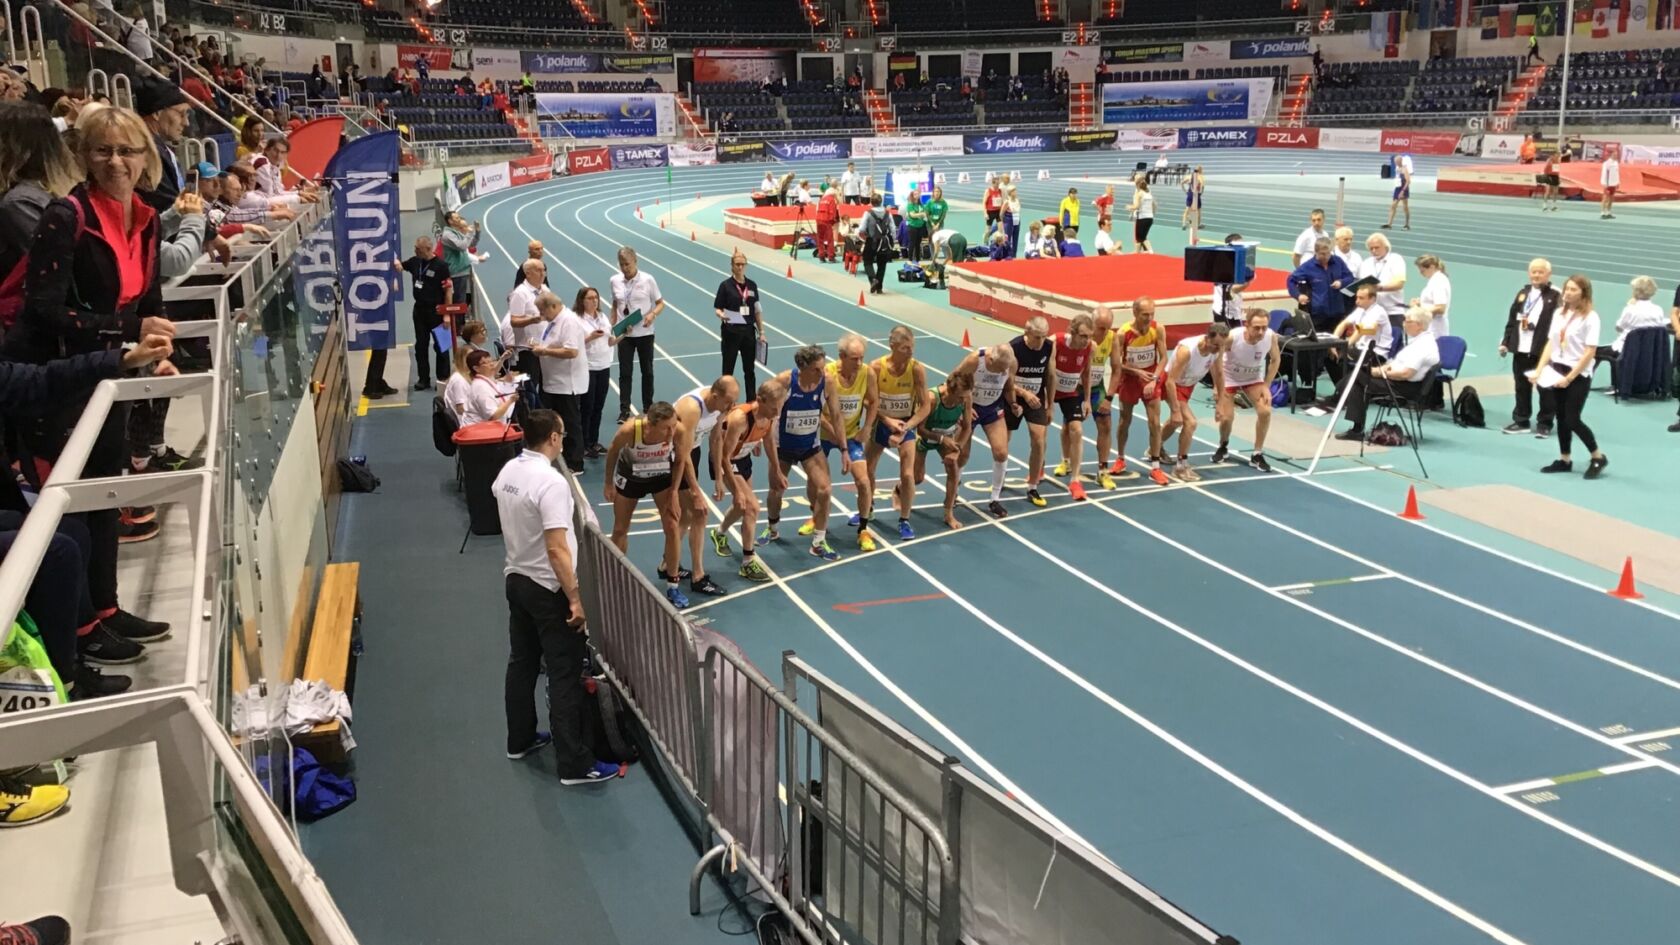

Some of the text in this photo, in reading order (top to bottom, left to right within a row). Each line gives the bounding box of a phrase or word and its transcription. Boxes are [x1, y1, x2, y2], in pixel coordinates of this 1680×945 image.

[260, 14, 270, 28] A2
[273, 15, 286, 30] B2
[1318, 20, 1335, 31] G2
[1296, 22, 1311, 32] F2
[434, 30, 446, 42] B2
[452, 30, 466, 42] C2
[1062, 32, 1076, 42] E2
[1086, 31, 1099, 42] F2
[652, 38, 667, 48] D2
[826, 38, 840, 48] D2
[881, 37, 895, 48] E2
[546, 54, 588, 68] polanik
[1469, 117, 1484, 130] G1
[1496, 116, 1508, 130] H1
[1200, 131, 1247, 140] TAMEX
[1267, 132, 1308, 144] PZLA
[996, 136, 1042, 150] polanik
[1384, 137, 1410, 147] ANIRO
[440, 148, 449, 161] B1
[626, 149, 661, 160] TAMEX
[796, 142, 838, 157] polanik
[575, 154, 602, 168] PZLA
[890, 402, 908, 410] 3920
[798, 418, 818, 426] 2438
